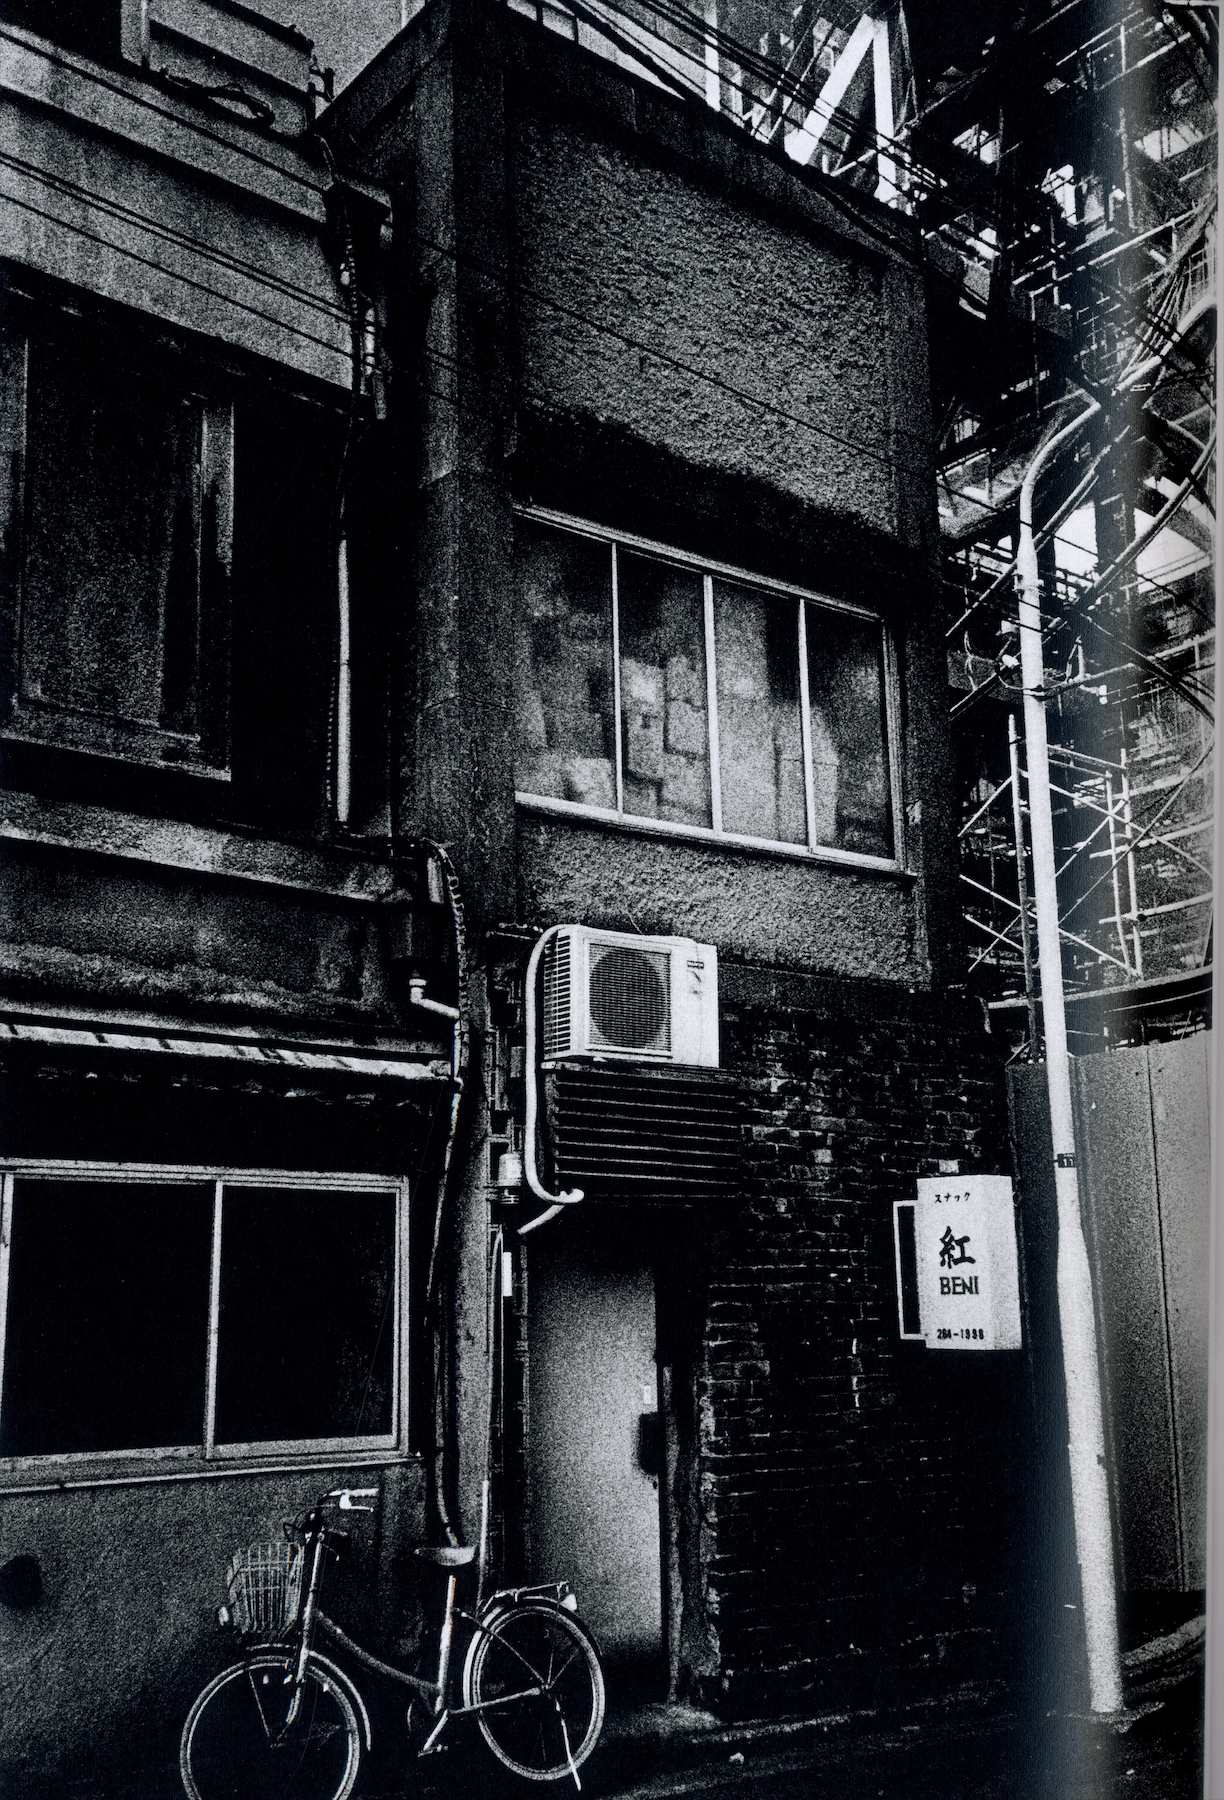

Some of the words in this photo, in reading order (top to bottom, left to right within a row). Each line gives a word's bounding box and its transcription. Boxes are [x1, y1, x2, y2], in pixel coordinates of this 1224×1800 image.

[934, 1192, 971, 1203] スナック
[938, 1225, 976, 1270] 紅
[939, 1276, 980, 1295] BENI
